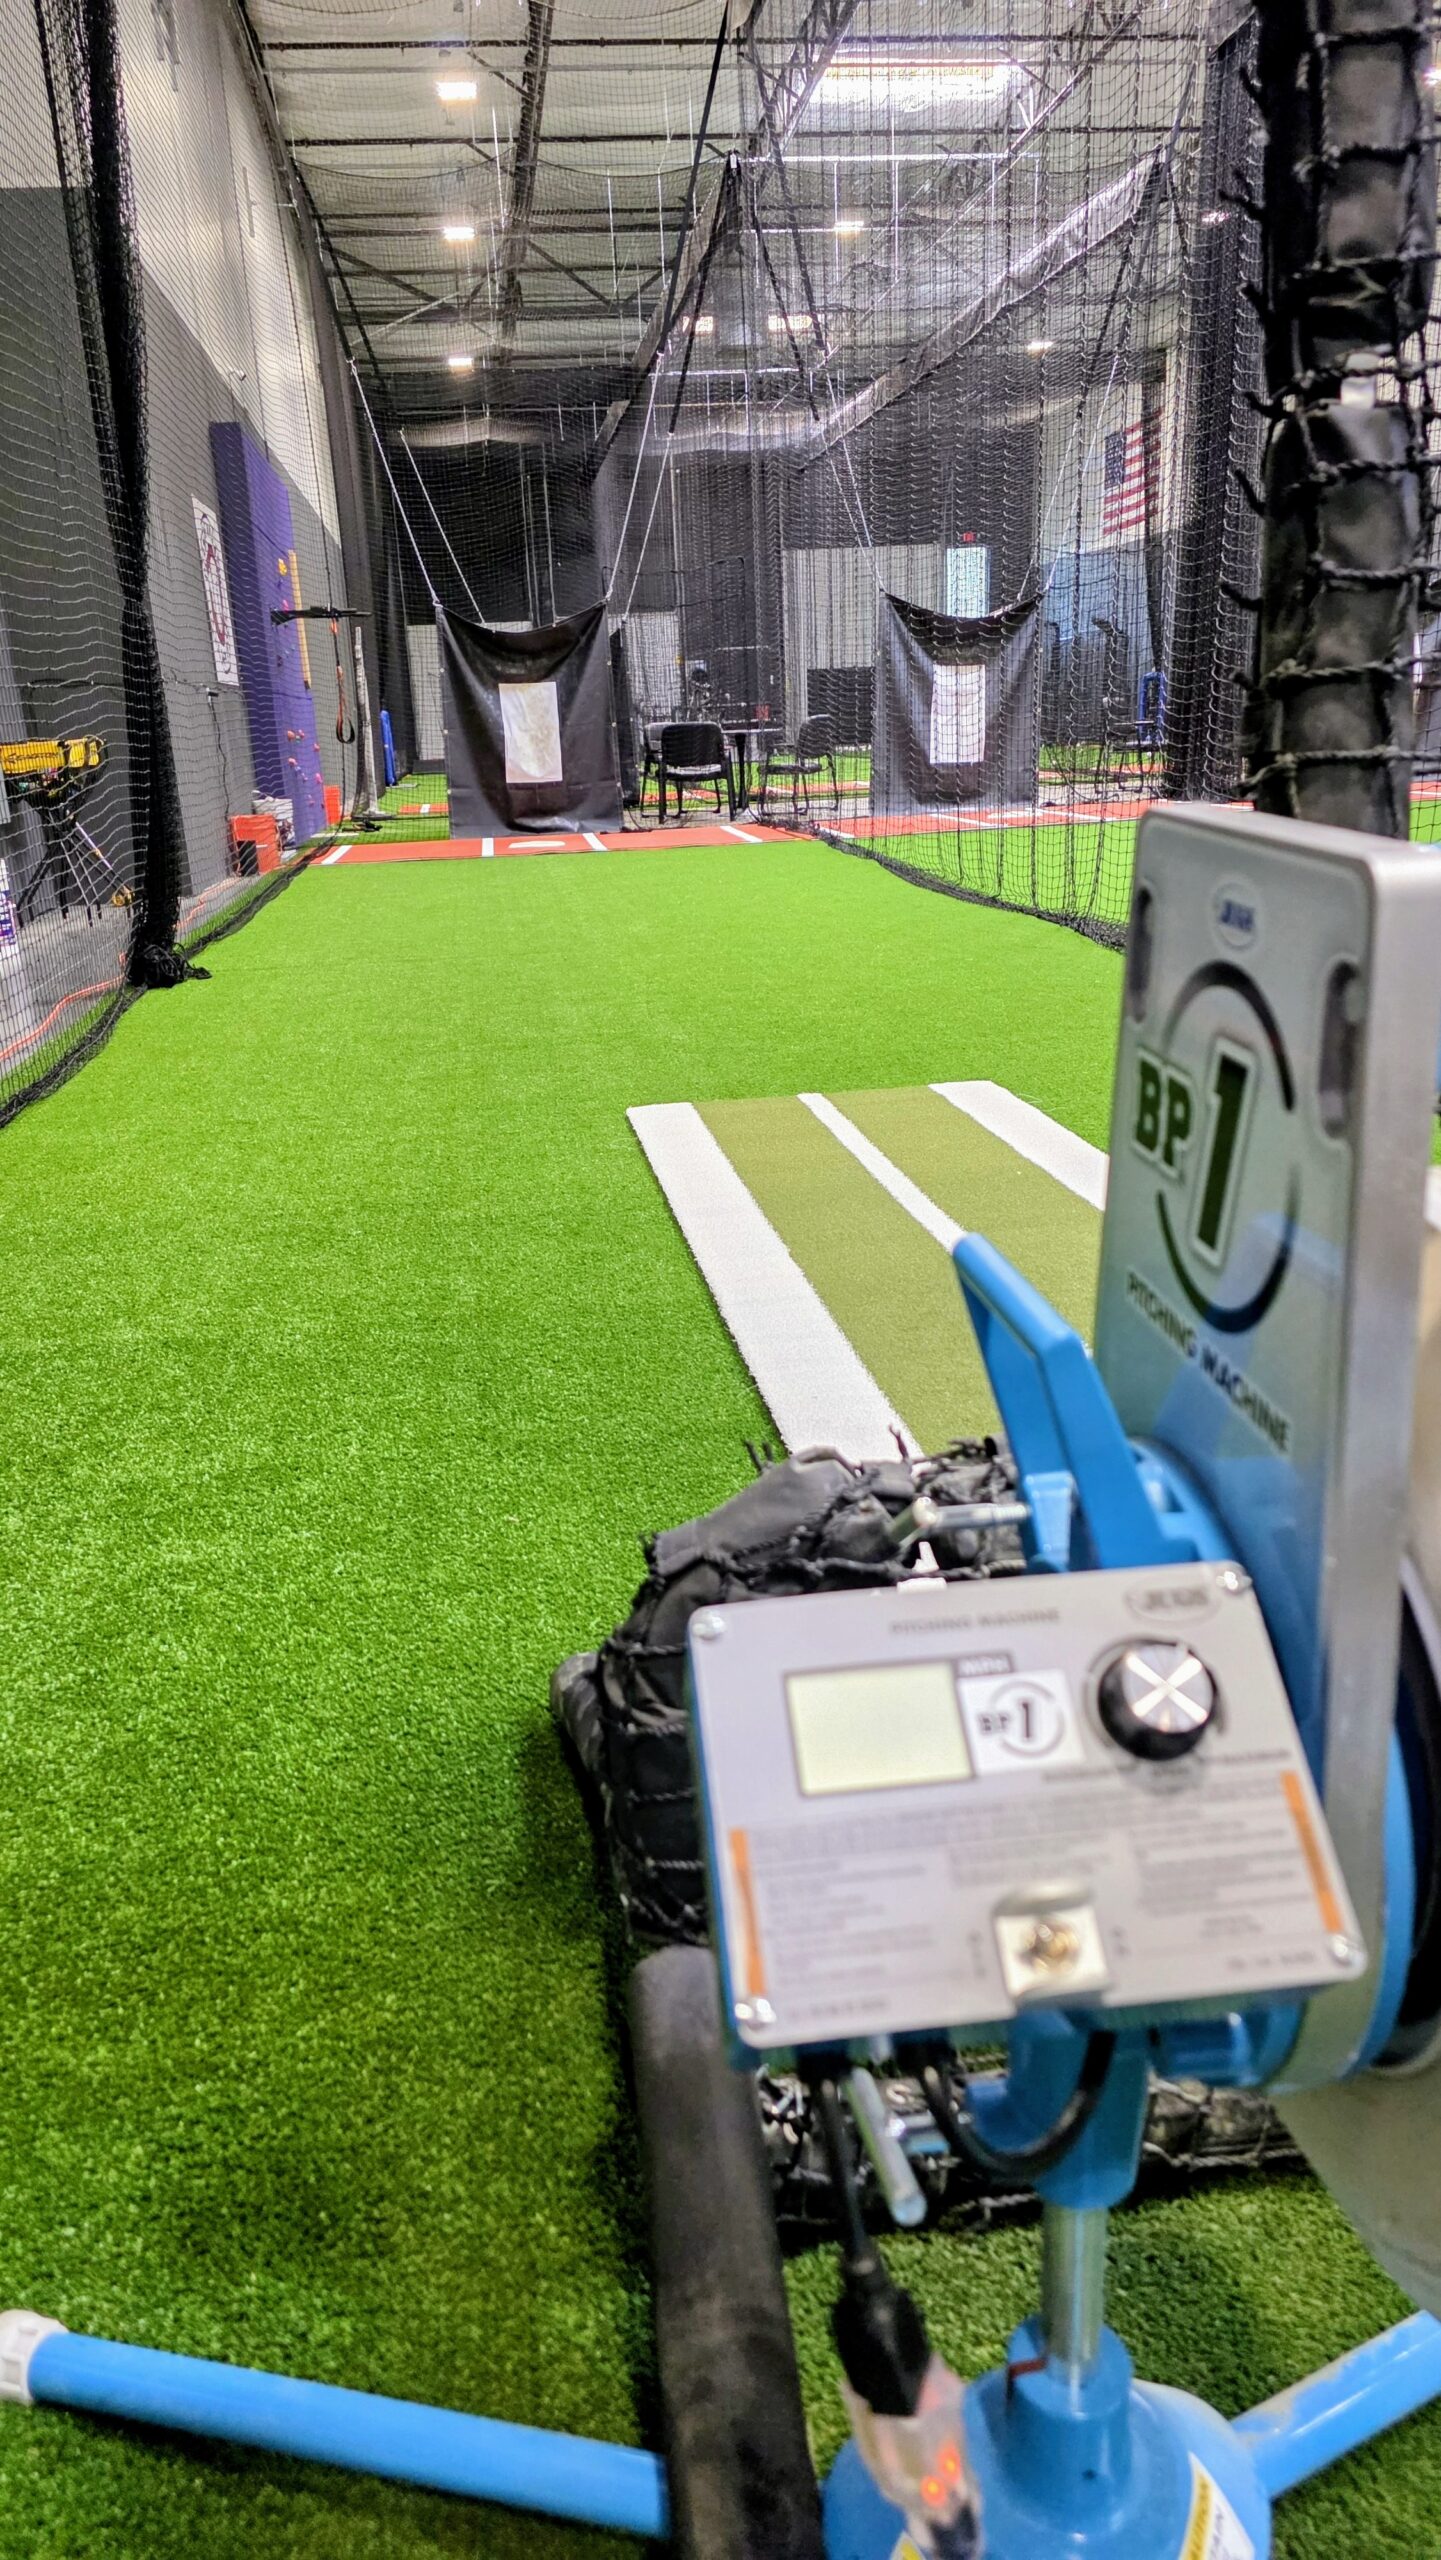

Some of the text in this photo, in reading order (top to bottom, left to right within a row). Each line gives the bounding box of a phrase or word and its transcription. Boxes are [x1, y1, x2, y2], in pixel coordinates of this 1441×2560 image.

[1134, 1050, 1251, 1254] BP 1
[1126, 1270, 1289, 1452] PITCHING MACHINE
